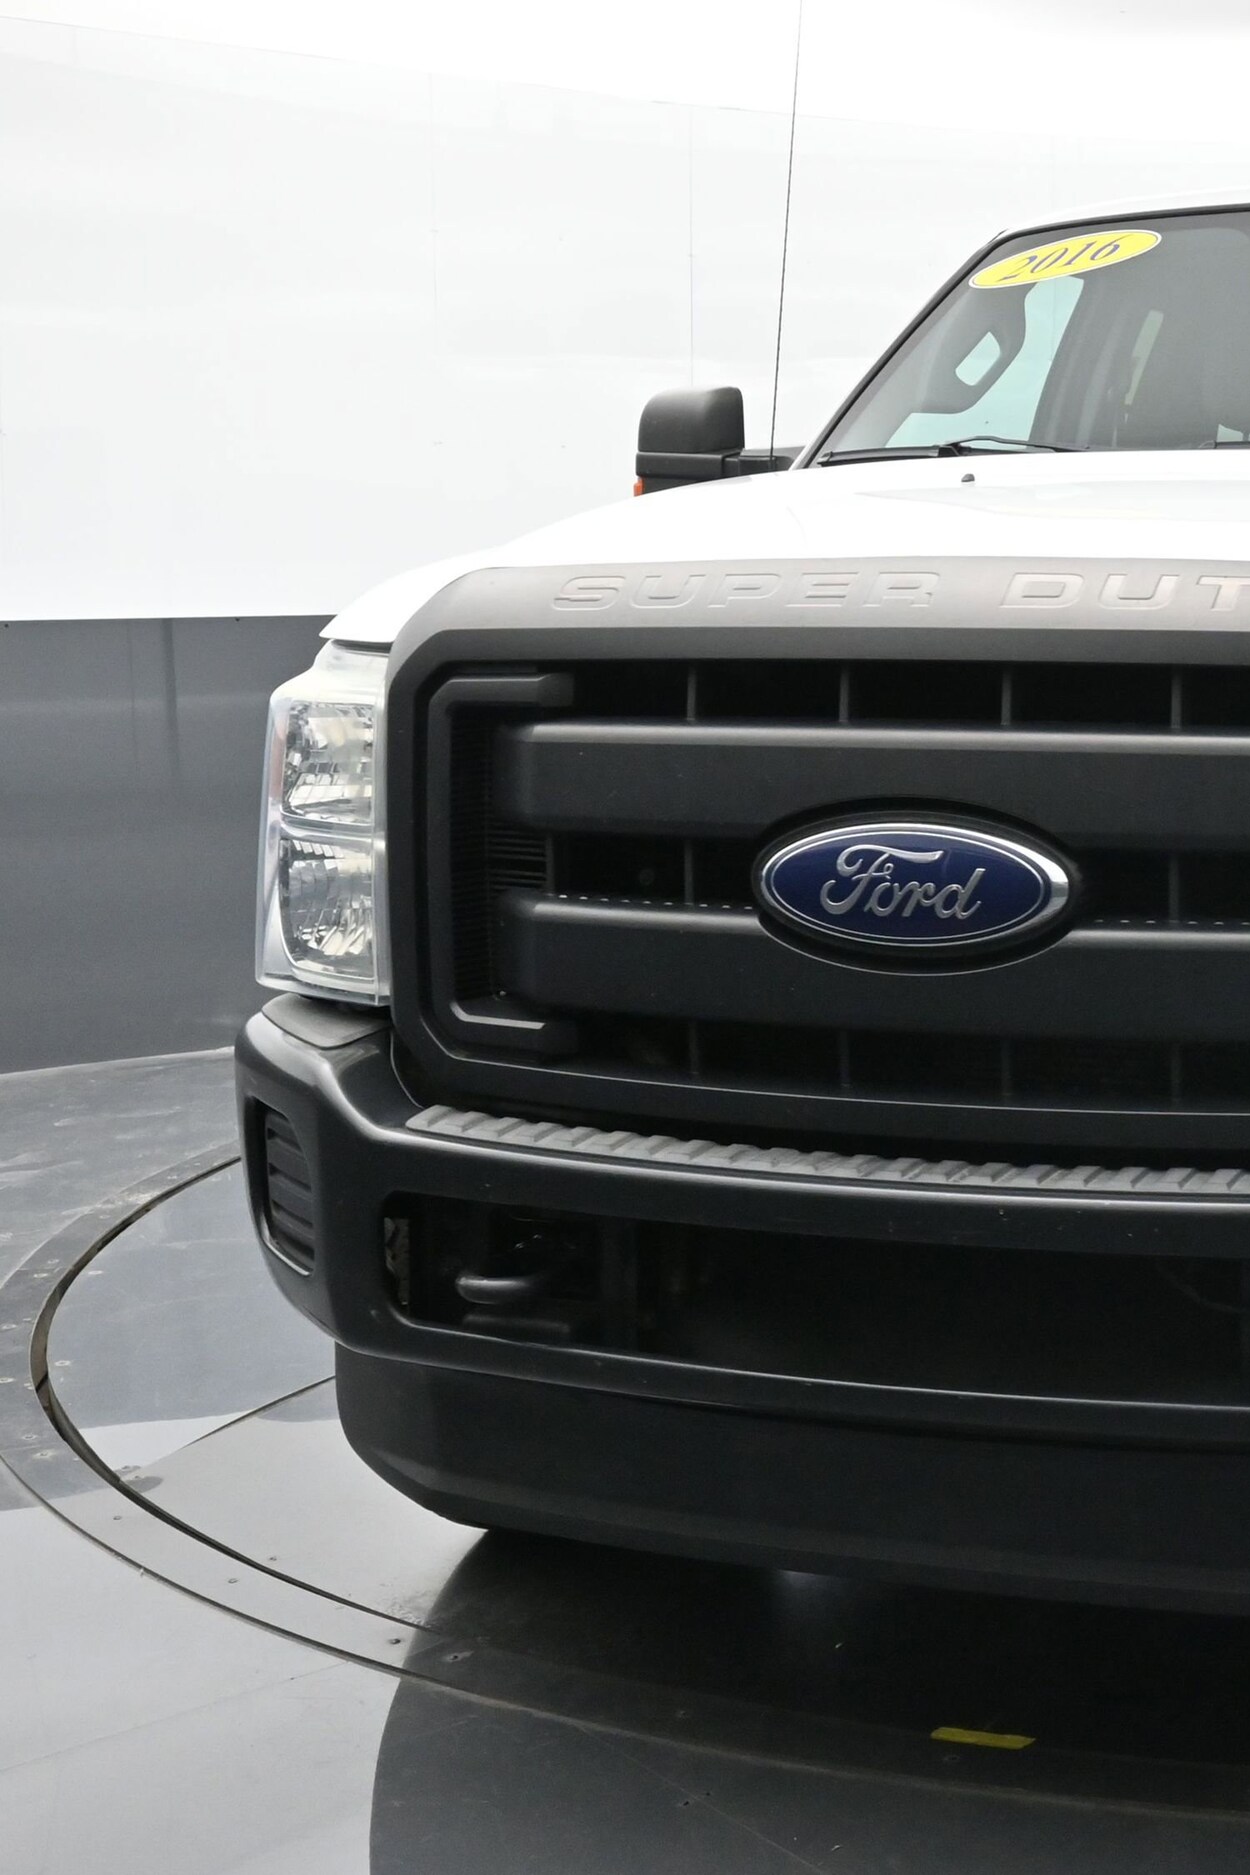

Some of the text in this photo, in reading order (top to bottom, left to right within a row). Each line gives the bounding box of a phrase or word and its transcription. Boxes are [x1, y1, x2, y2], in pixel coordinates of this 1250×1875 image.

[996, 234, 1134, 282] 2016
[549, 570, 942, 611] SUPER
[819, 844, 986, 920] Ford
